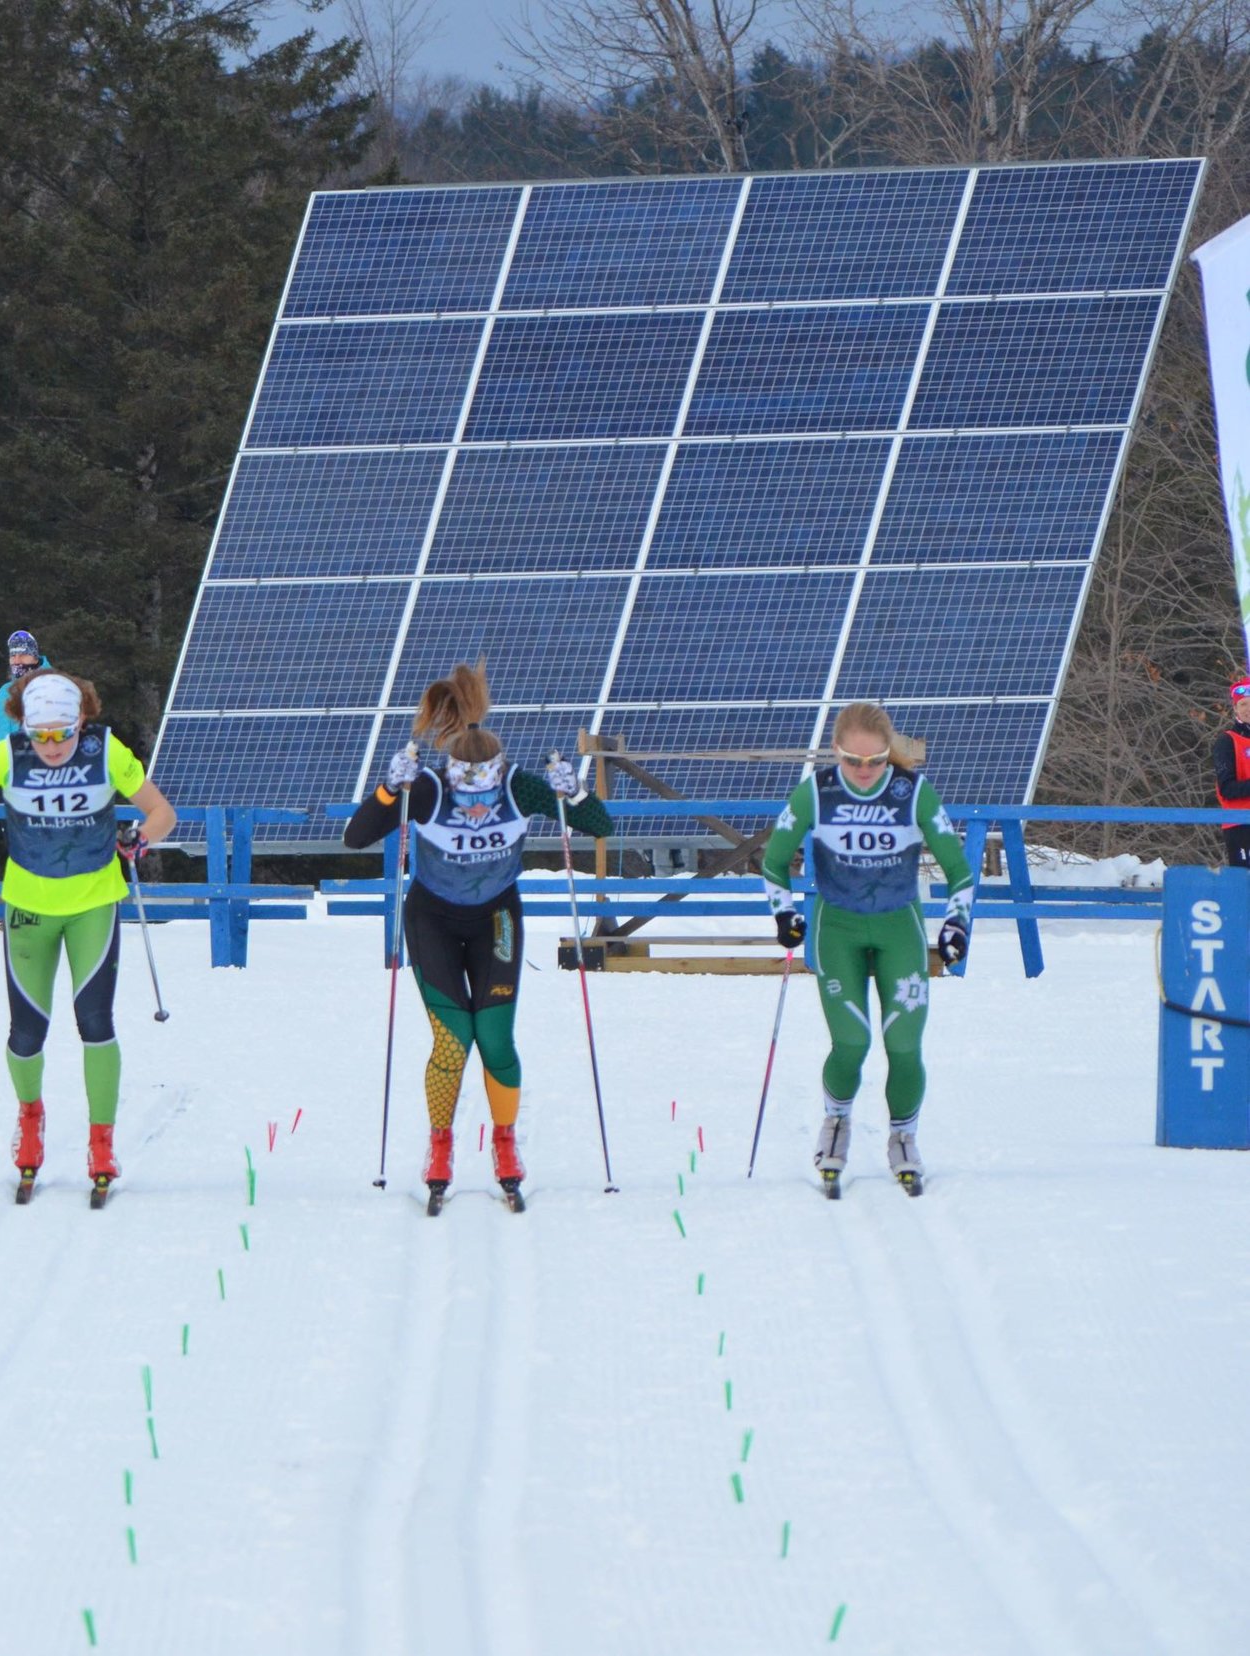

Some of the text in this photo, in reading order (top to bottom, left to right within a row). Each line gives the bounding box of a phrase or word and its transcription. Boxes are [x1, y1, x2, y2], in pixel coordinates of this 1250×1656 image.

[24, 765, 92, 787] SWIX
[32, 792, 90, 813] 112
[832, 804, 900, 824] SWIX
[451, 831, 507, 851] 108
[839, 831, 896, 851] 109
[1190, 899, 1226, 1092] START
